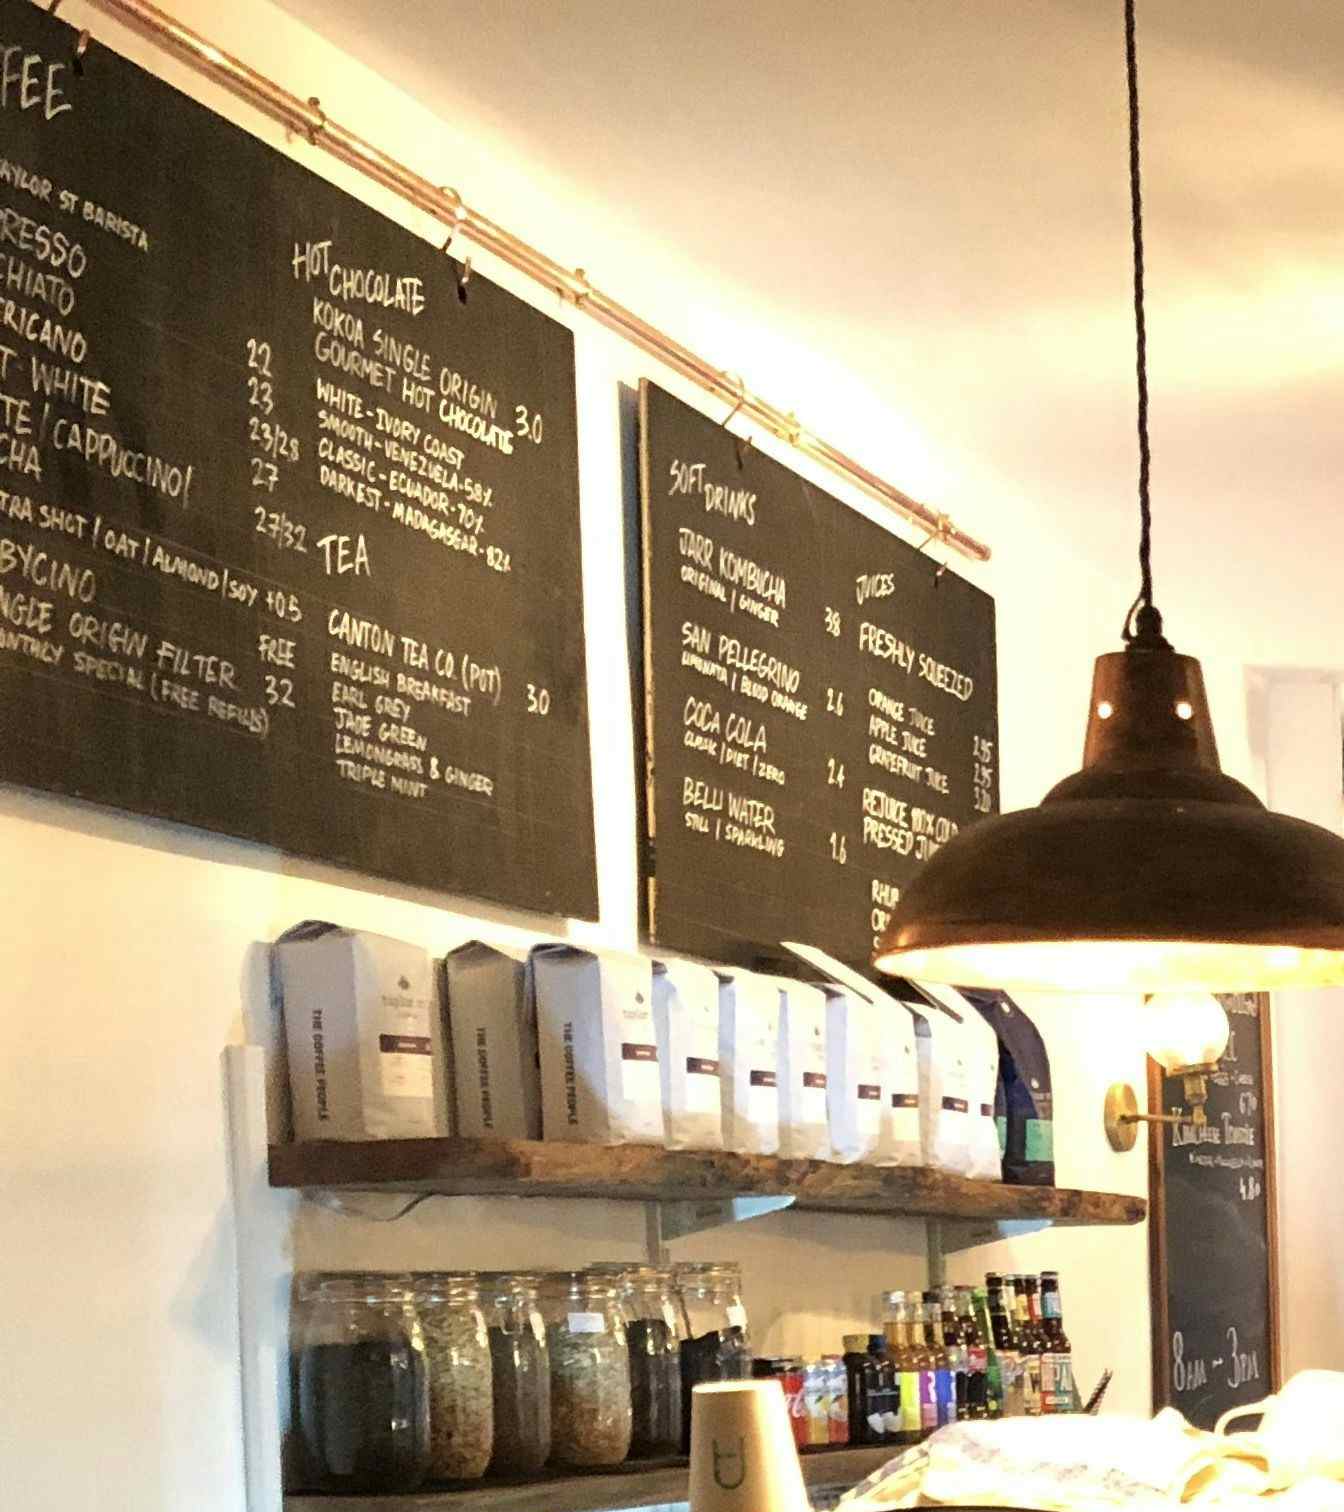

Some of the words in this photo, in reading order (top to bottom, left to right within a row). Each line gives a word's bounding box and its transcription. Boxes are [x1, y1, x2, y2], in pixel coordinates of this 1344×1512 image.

[3, 46, 72, 120] FEE
[83, 201, 149, 252] BARISTA
[292, 241, 332, 283] HOT
[329, 264, 425, 316] CHOCOLATE
[0, 297, 87, 363] RICANO
[313, 297, 364, 349] KOKOA
[373, 329, 432, 381] SINGLE
[440, 367, 498, 419] ORIGIN
[32, 357, 111, 415] WHITE
[315, 331, 396, 392] GOURMET
[402, 378, 436, 414] HOT
[439, 399, 514, 454] CHOCOLATE
[424, 434, 465, 470] COAST
[668, 459, 707, 496] SOFT
[704, 483, 757, 526] DRINKS
[40, 505, 88, 539] SHOT
[228, 579, 258, 607] SOY
[317, 534, 371, 577] TEA
[679, 527, 714, 572] JARR
[719, 546, 787, 609] KOMBUCHA
[681, 565, 727, 602] ORIGINAL
[739, 594, 780, 628] GINGER
[856, 573, 895, 605] JUICES
[69, 612, 148, 658] ORIGIN
[156, 641, 241, 690] FILTER
[259, 634, 297, 669] FREE
[328, 608, 396, 657] CANTON
[401, 637, 430, 671] TEA
[681, 622, 712, 654] SAN
[718, 635, 800, 693] PELLEGRINO
[859, 622, 915, 674] FRESHLY
[918, 653, 974, 701] SQUEEZED
[331, 652, 390, 688] ENGLISH
[397, 673, 471, 717] BREAKFAST
[332, 682, 368, 710] EARL
[375, 695, 411, 723] GREY
[771, 690, 809, 721] ORANGE
[868, 688, 904, 722] ORANGE
[333, 707, 373, 737] JADE
[379, 722, 428, 752] GREEN
[684, 696, 720, 734] COCA
[725, 713, 767, 753] COLA
[868, 714, 898, 746] APPLE
[335, 733, 424, 775] LEMONGRASS
[445, 766, 494, 797] GINGER
[336, 759, 386, 789] TRIPLE
[390, 776, 428, 798] MINT
[685, 812, 709, 833] STILL
[725, 823, 785, 858] SPARKLING
[728, 792, 776, 835] WATER
[863, 816, 914, 856] PRESSED
